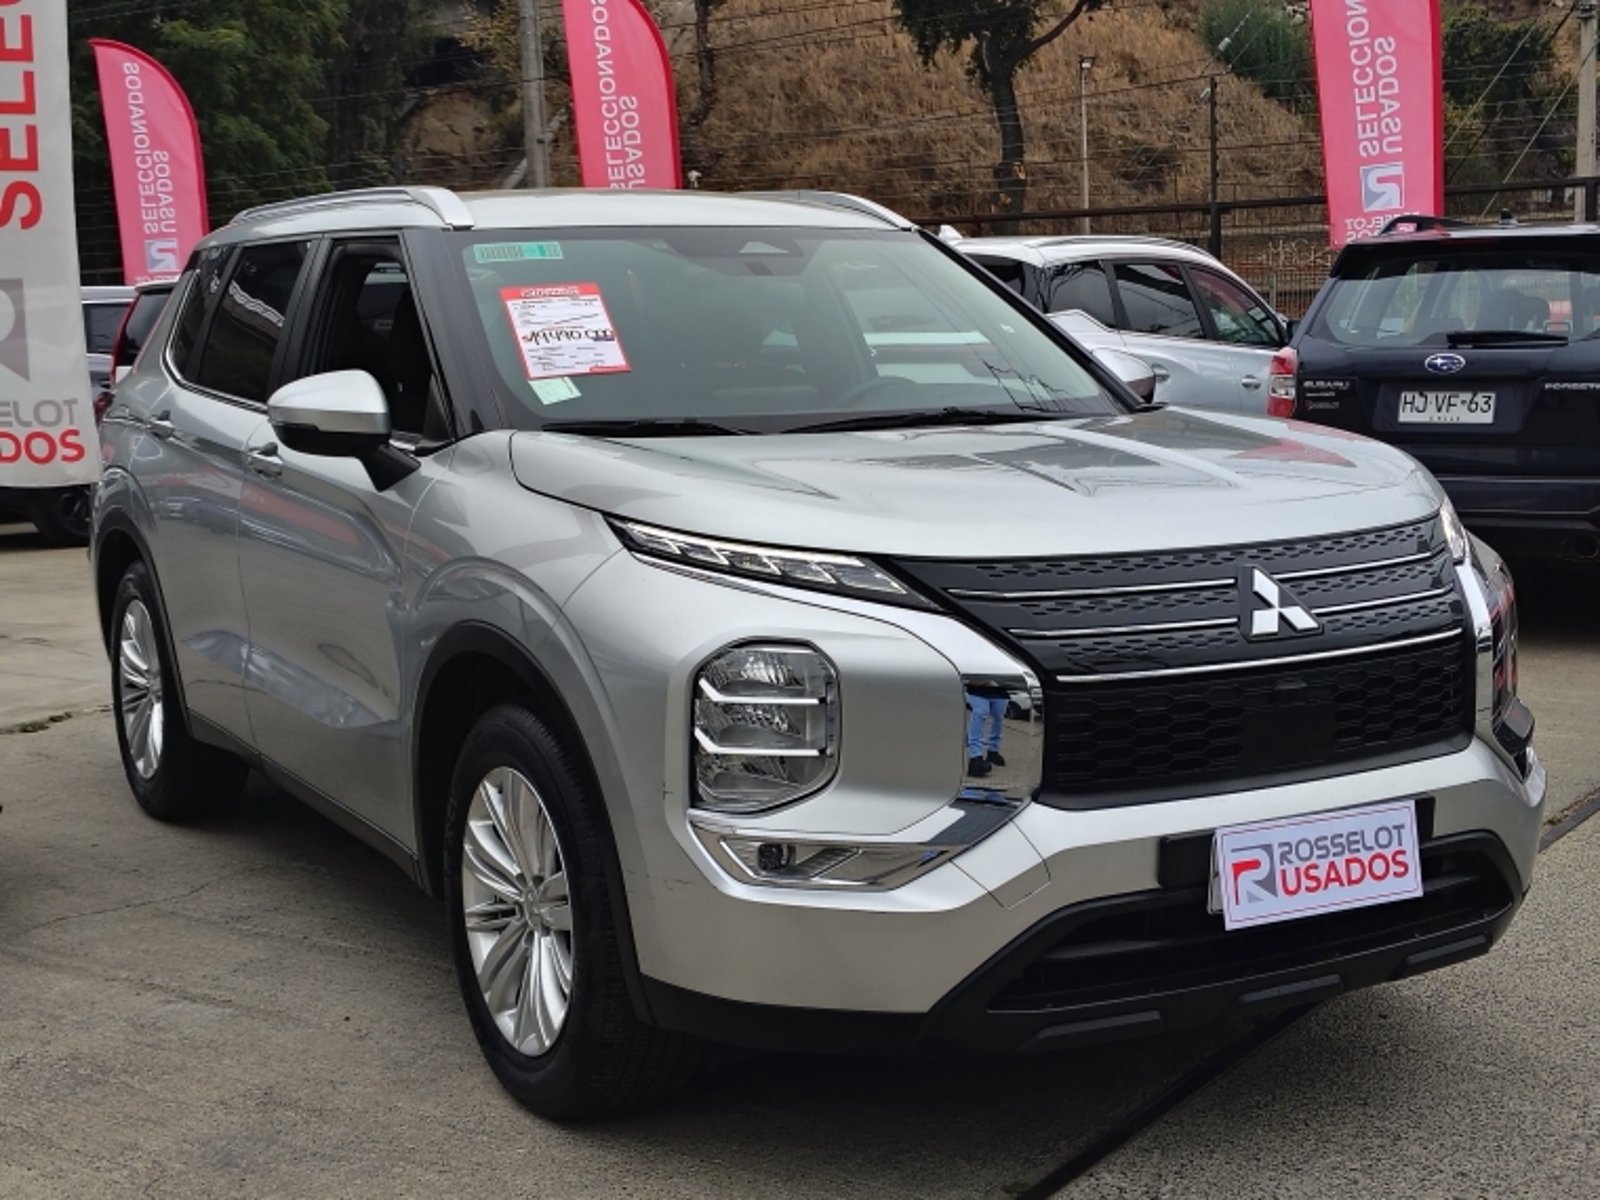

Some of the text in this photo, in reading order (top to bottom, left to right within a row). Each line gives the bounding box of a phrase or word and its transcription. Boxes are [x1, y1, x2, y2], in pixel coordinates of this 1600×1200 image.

[0, 0, 43, 230] SELE
[1278, 824, 1405, 865] ROSSELOT
[1280, 850, 1409, 896] USADOS
